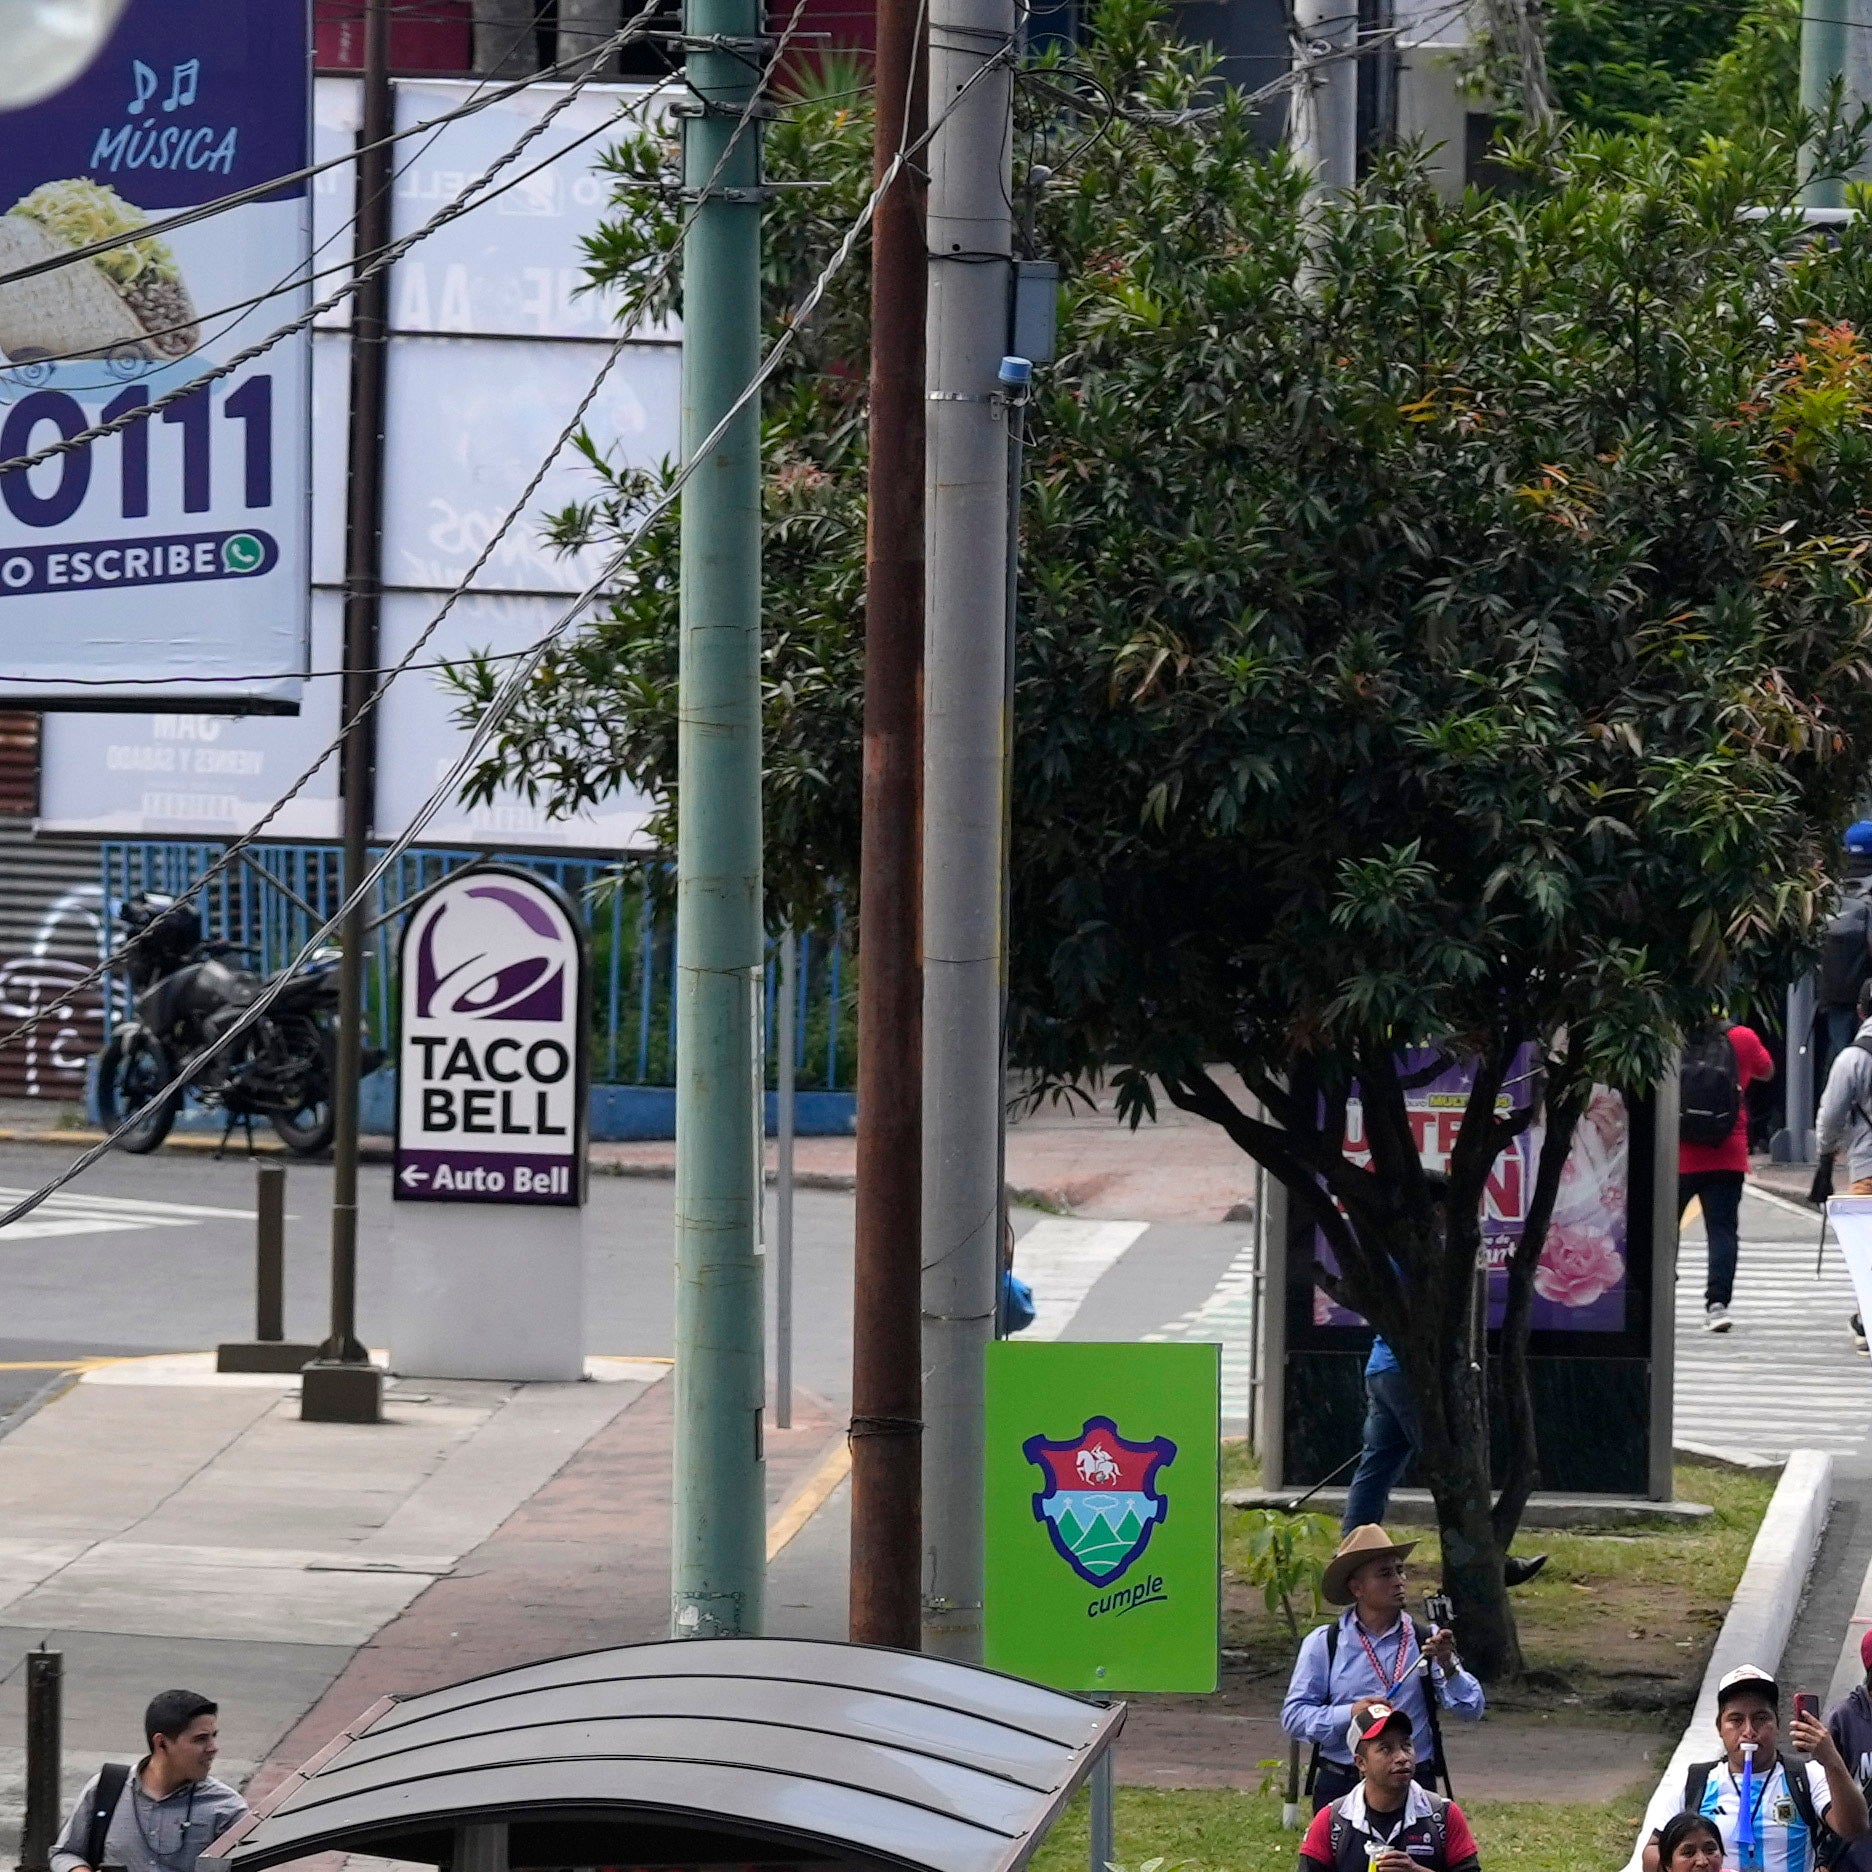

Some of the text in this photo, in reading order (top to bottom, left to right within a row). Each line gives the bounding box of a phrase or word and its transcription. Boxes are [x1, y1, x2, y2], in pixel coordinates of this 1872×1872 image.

[91, 119, 239, 175] MÚSICA
[3, 541, 216, 586] O ESCRIBE
[411, 1037, 569, 1083] TACO
[423, 1089, 567, 1136] BELL
[432, 1163, 569, 1194] Auto Bell
[1087, 1573, 1164, 1618] cumple
